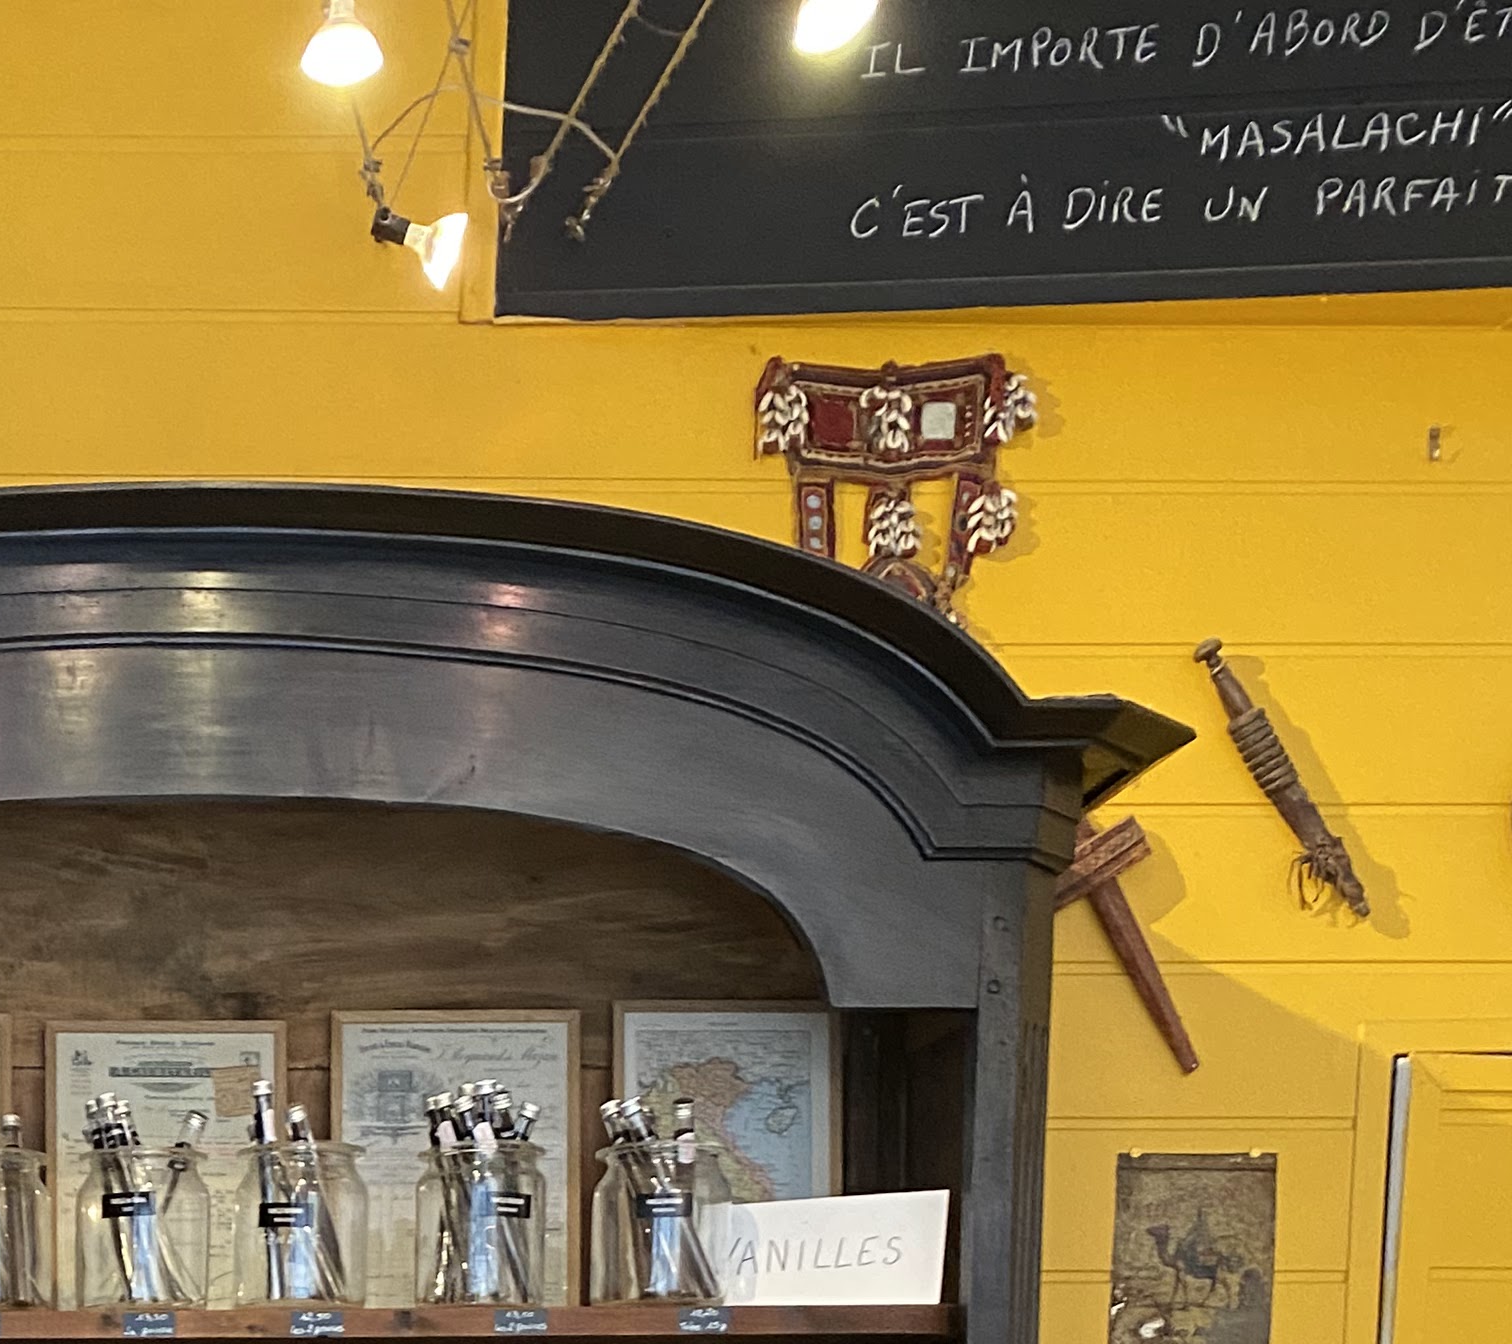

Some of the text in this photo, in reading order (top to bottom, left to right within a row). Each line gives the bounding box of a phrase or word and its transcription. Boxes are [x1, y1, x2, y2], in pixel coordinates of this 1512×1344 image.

[861, 41, 926, 79] IL
[960, 24, 1159, 72] IMPORTE
[1192, 9, 1389, 67] D'ABORD
[850, 184, 984, 238] C'EST
[1205, 186, 1269, 221] UN
